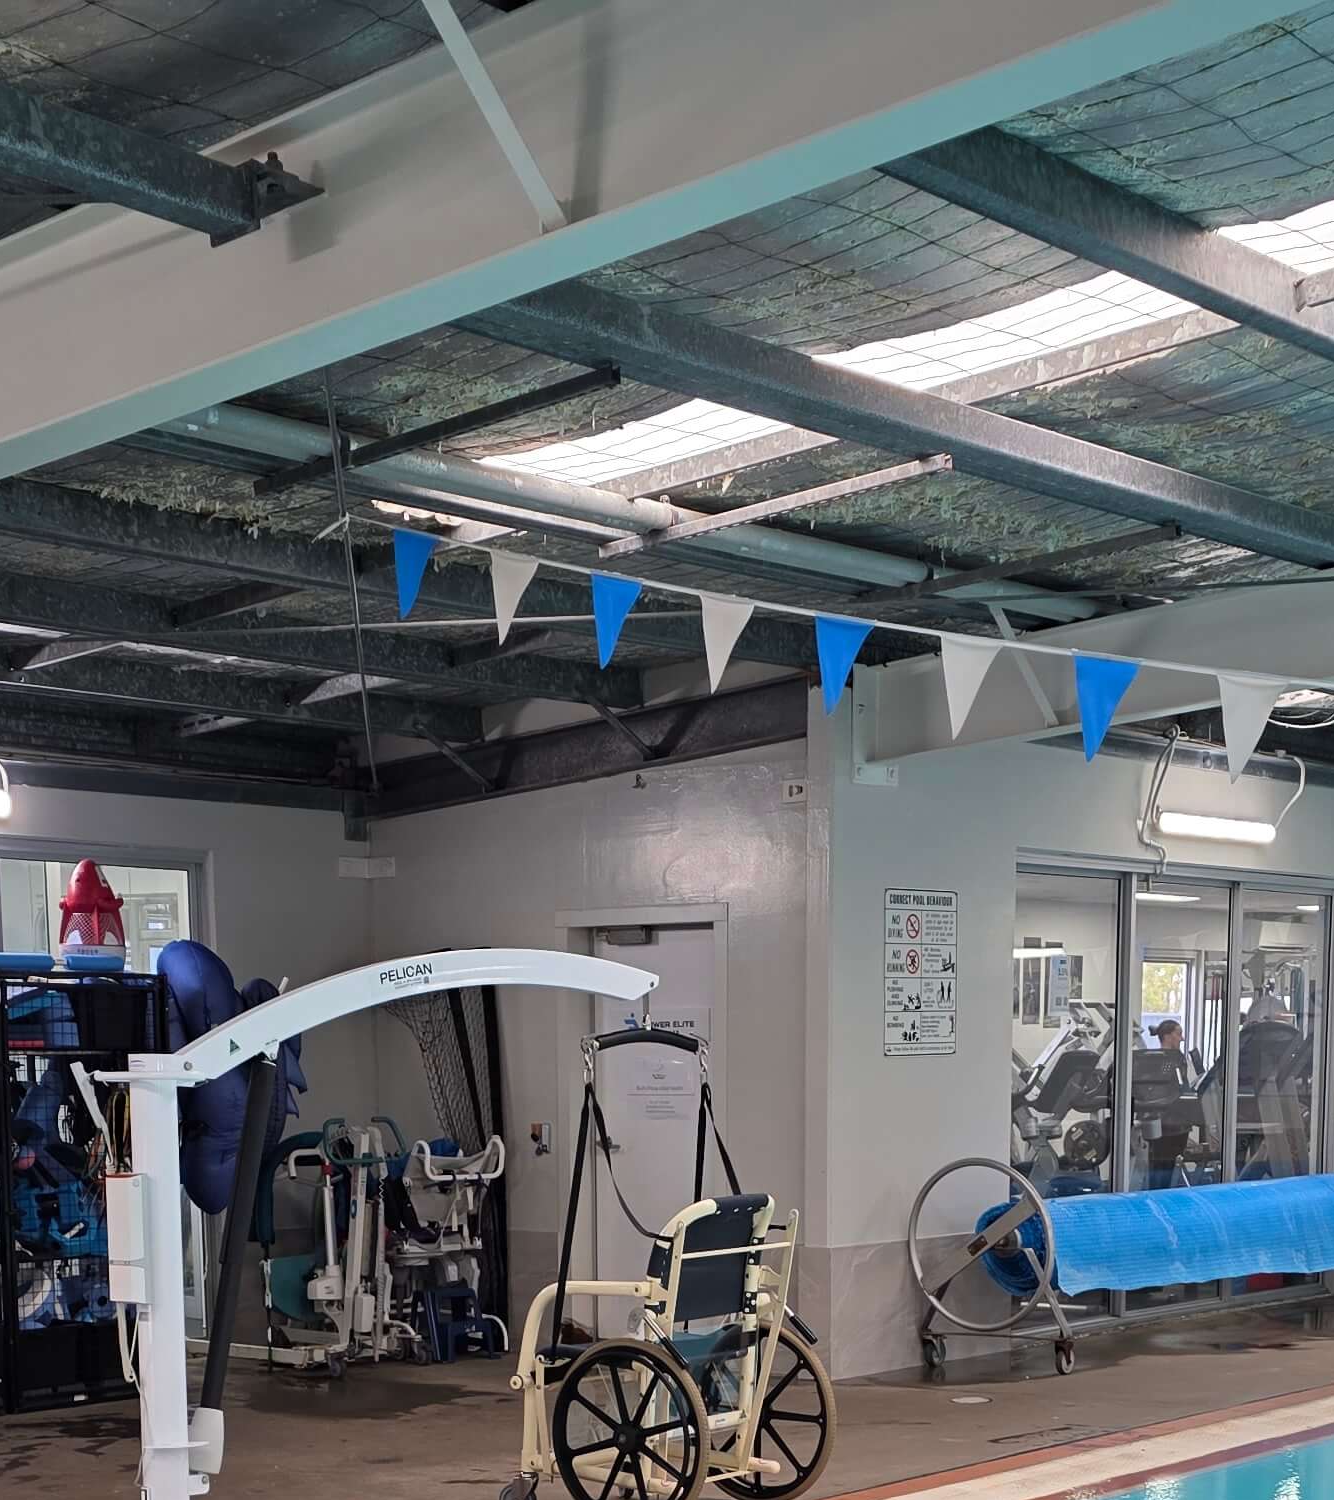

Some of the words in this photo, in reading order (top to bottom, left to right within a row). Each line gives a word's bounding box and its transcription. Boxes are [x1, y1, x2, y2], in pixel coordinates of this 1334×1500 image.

[889, 893, 912, 905] CORRECT
[912, 894, 925, 906] POOL
[927, 895, 953, 907] BEHAVIOUR
[891, 914, 901, 925] NO
[891, 949, 901, 960] NO
[379, 962, 433, 985] PELICAN
[673, 1020, 695, 1028] ELITE
